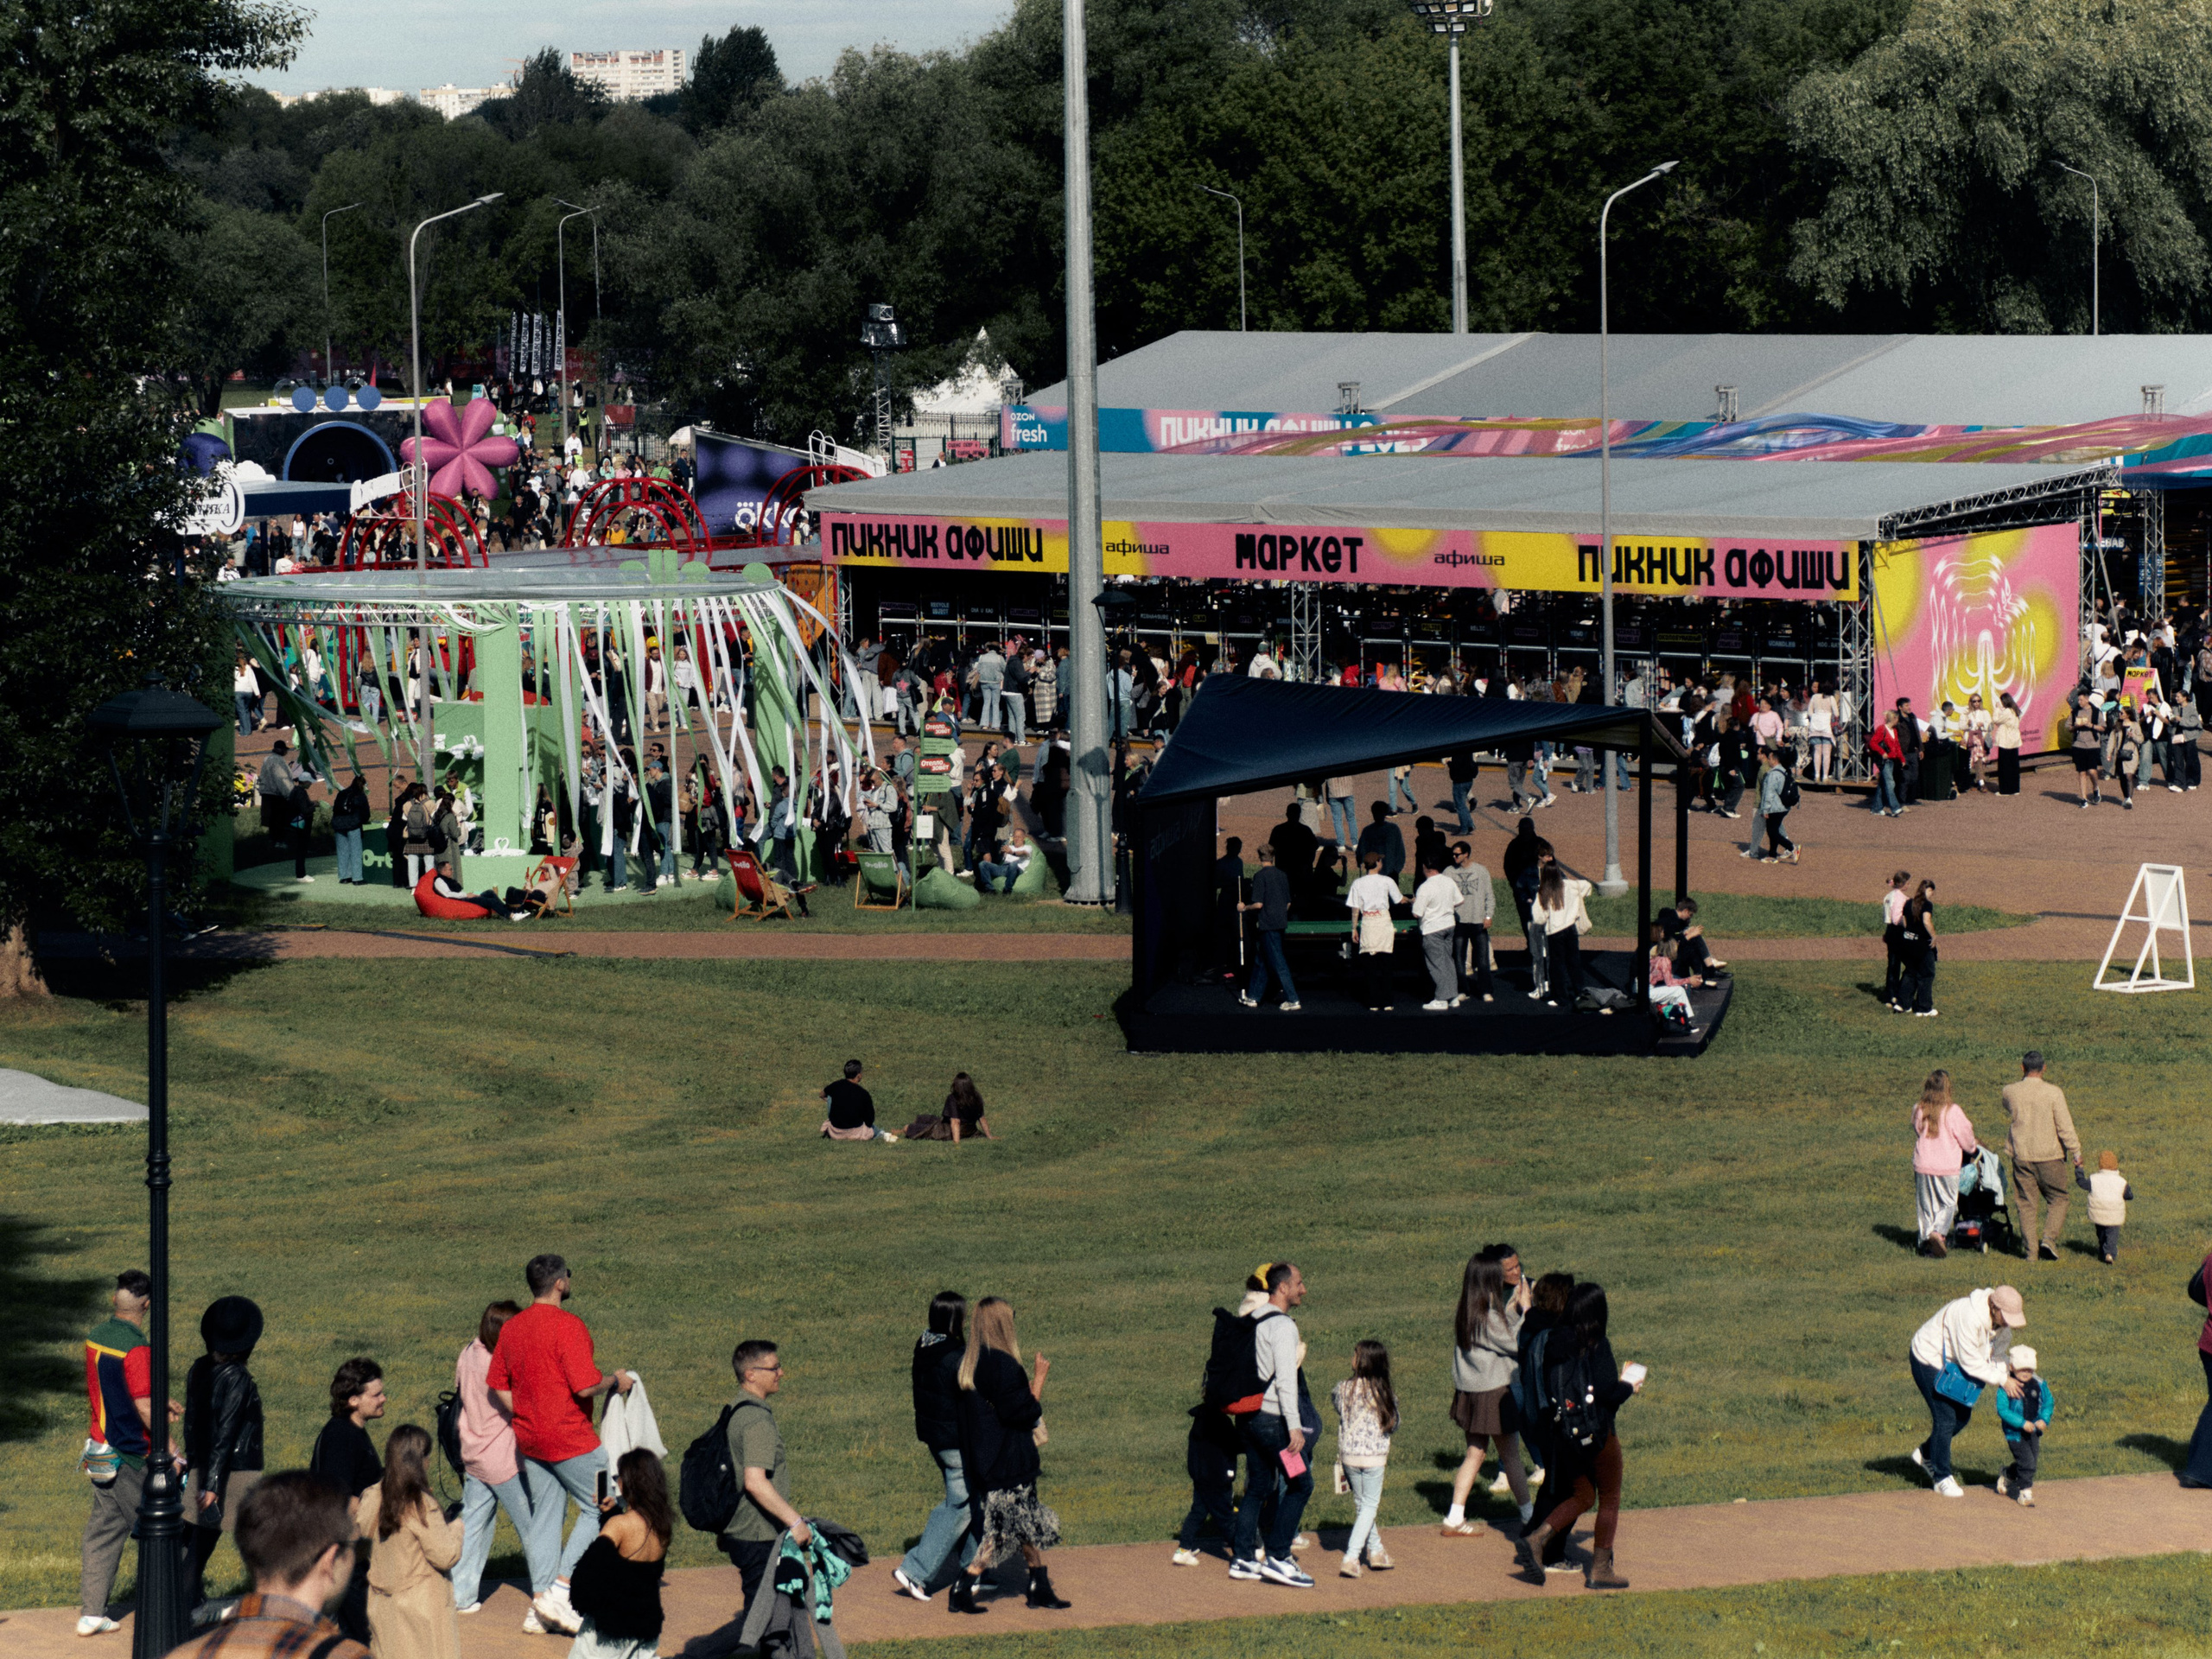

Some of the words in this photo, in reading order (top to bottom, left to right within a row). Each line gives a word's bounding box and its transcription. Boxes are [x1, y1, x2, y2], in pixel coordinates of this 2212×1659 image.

[1010, 413, 1035, 422] OZON
[1010, 423, 1047, 443] fresh
[832, 522, 938, 559] ПИКНИК
[1105, 539, 1170, 556] афиша
[1434, 550, 1505, 567] афиша
[1579, 544, 1715, 587] ПИКНИК
